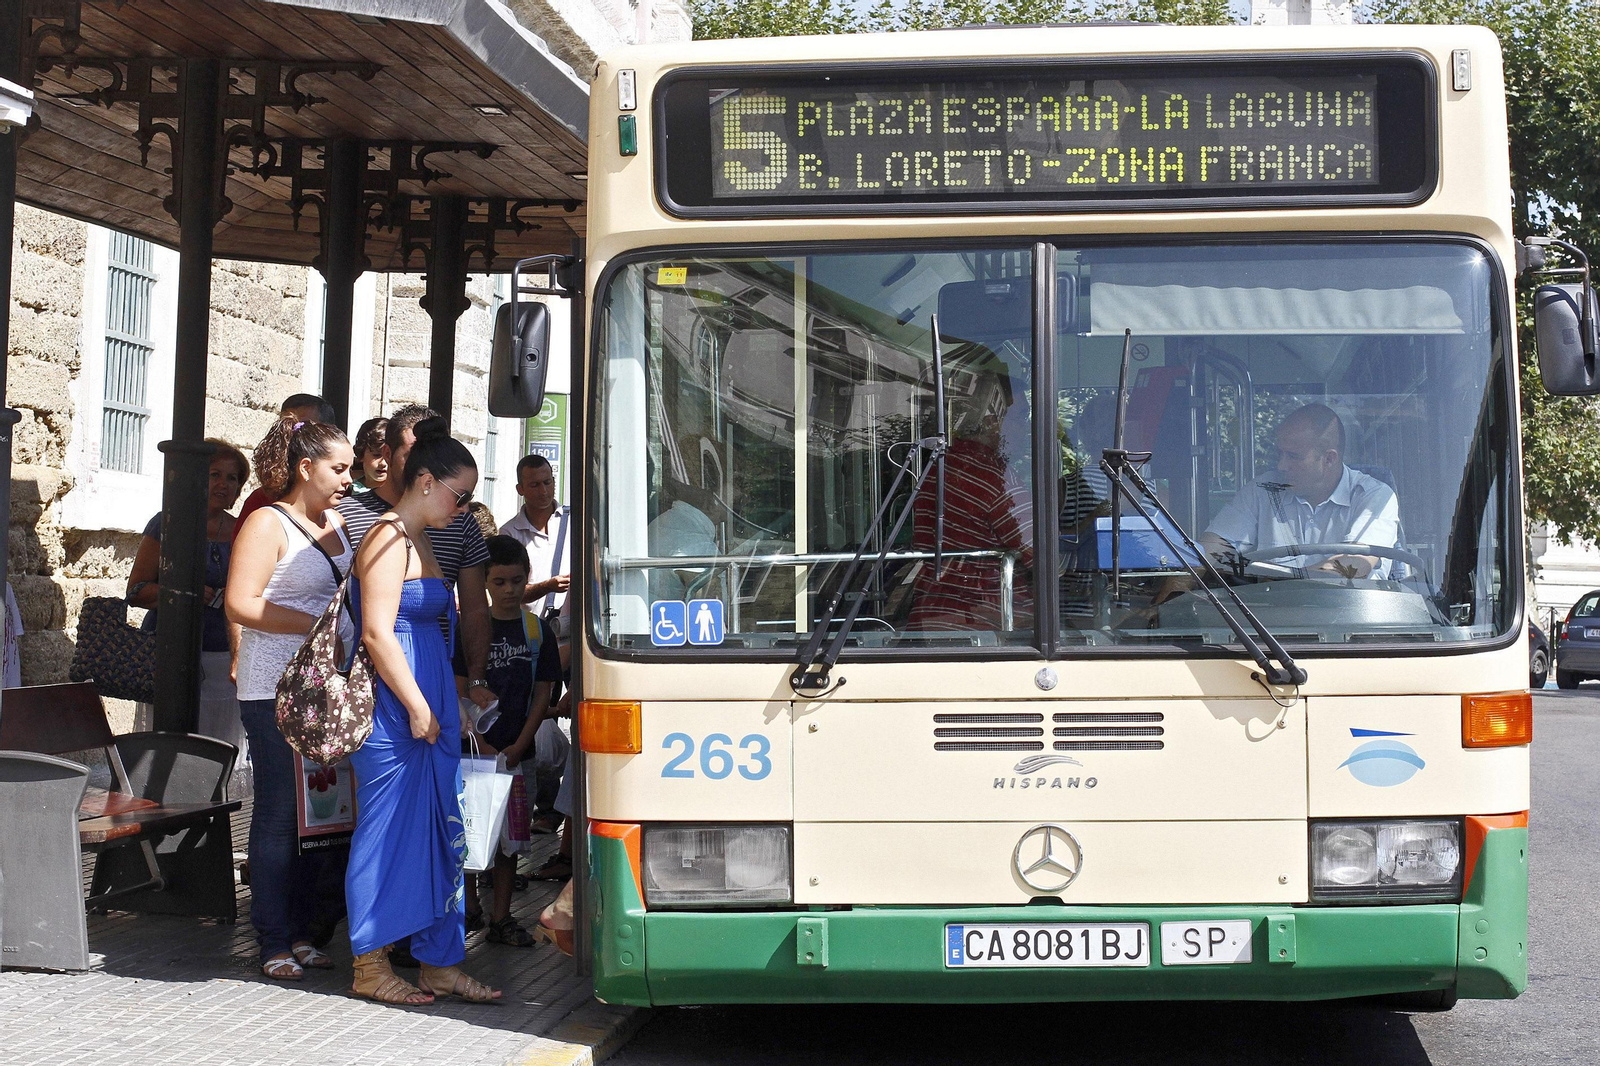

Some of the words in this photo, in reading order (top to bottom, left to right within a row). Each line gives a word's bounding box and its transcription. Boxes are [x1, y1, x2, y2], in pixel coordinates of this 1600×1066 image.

[1206, 90, 1372, 128] LAGUNA
[723, 96, 788, 190] 5
[798, 154, 840, 189] B.
[1200, 144, 1373, 182] FRANCA
[531, 448, 555, 458] 1501
[661, 732, 773, 781] 263
[993, 777, 1098, 789] HISPANO
[952, 949, 960, 959] E
[1183, 927, 1227, 958] SP
